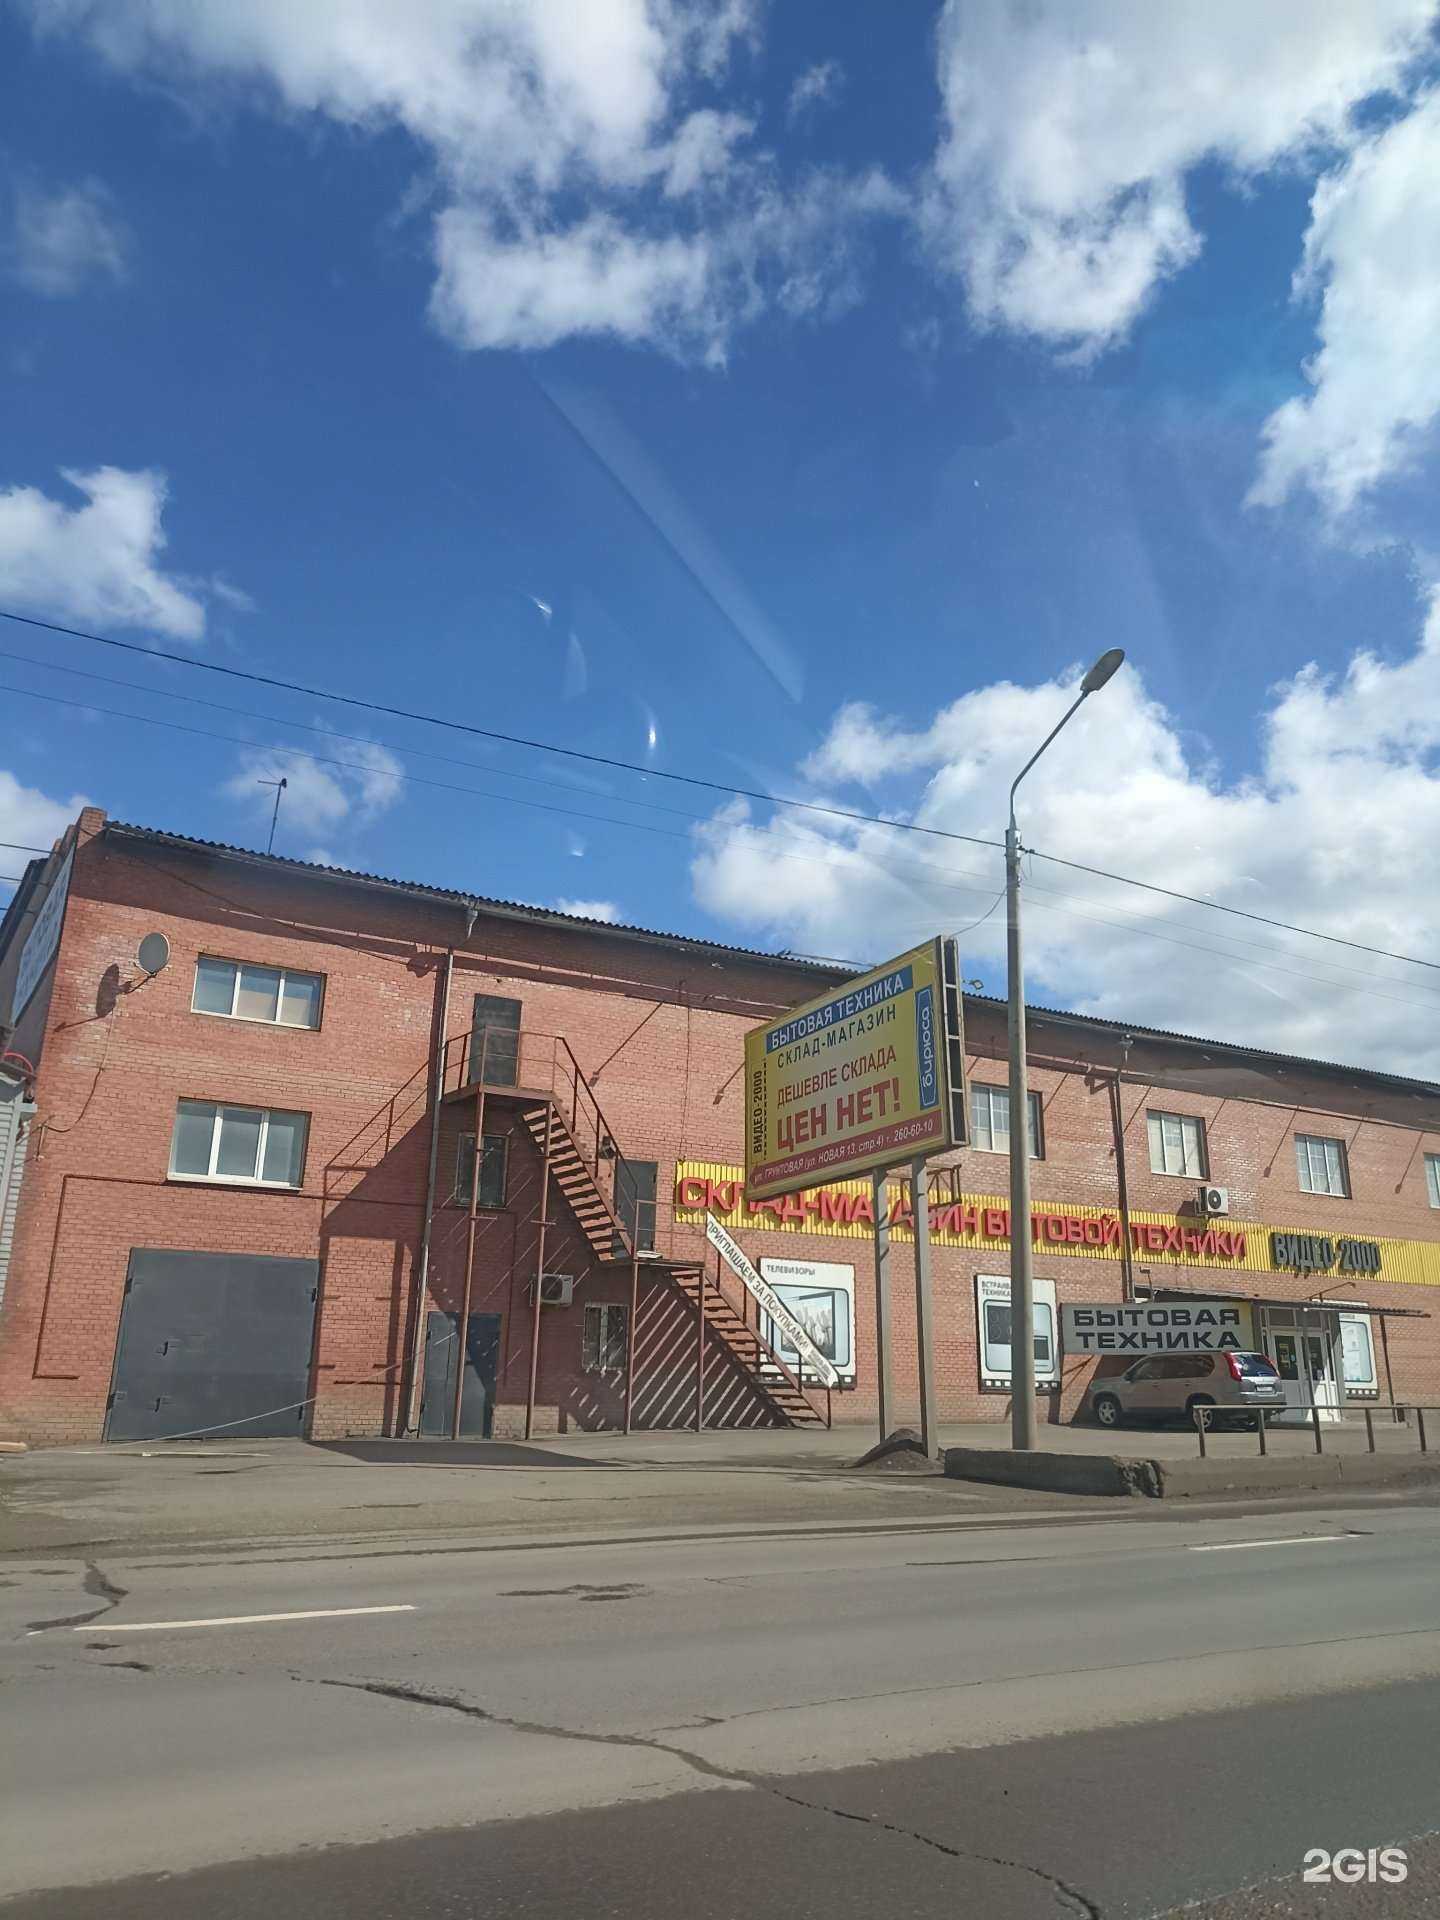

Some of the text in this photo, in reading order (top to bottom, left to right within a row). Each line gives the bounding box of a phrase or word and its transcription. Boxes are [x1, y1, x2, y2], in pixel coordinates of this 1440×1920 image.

[771, 974, 904, 1048] БЫТОВАЯ ТЕХНИКА
[777, 1004, 896, 1069] СКЛАД-МАГАЗИН
[777, 1045, 897, 1110] ДЕШЕВЛЕ СКЛАДА
[752, 1070, 764, 1154] ВИДЕО-2000
[777, 1077, 901, 1152] ЦЕН НЕТ!
[818, 1145, 846, 1163] НОВАЯ
[708, 1221, 756, 1285] ПРИГЛАШАЕМ
[752, 1277, 765, 1297] ЗА
[986, 1208, 1123, 1247] БТОВОЙ
[1130, 1222, 1247, 1257] ТЕХНИКИ
[766, 1264, 816, 1276] ТЕЛЕВИЗОРЫ
[1073, 1309, 1240, 1326] БЫТОВАЯ
[1076, 1331, 1241, 1349] ТЕХНИКА
